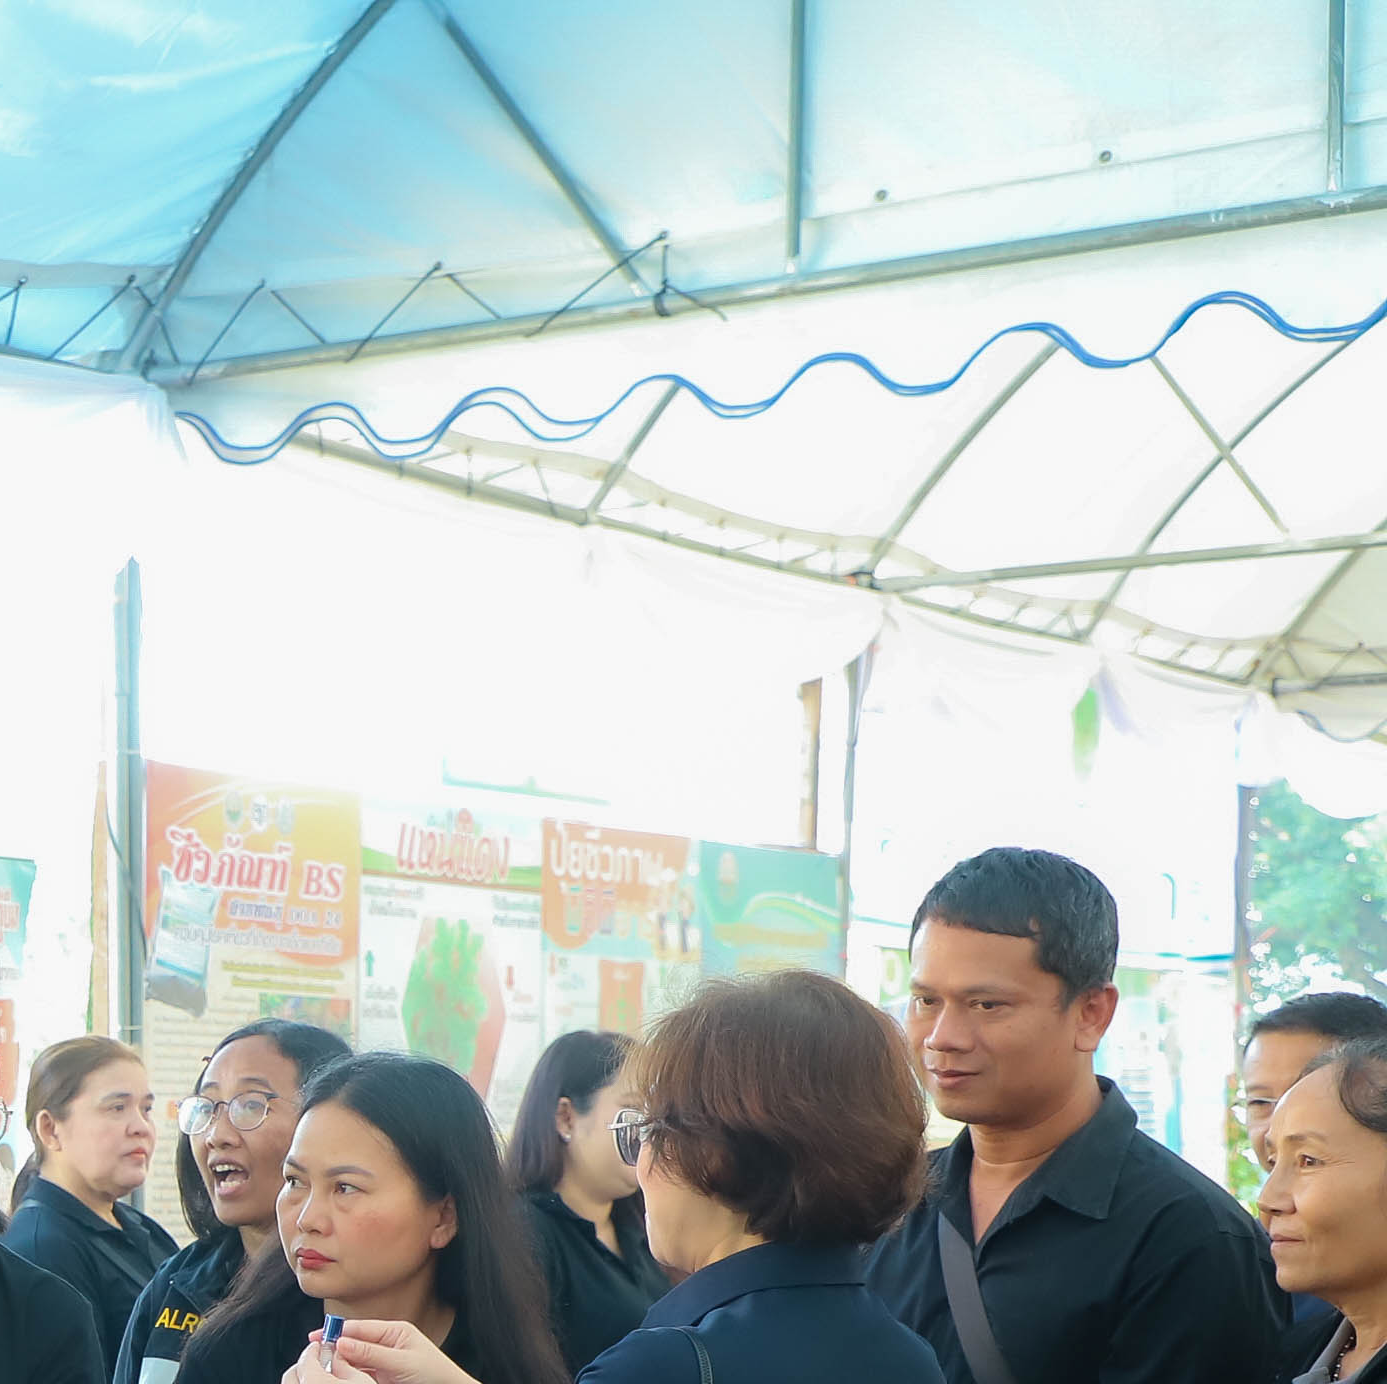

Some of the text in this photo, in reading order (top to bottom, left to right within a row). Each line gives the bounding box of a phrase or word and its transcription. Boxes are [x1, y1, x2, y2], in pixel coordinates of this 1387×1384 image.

[168, 827, 343, 898] ชีวภัณฑ์ BS
[155, 1307, 205, 1334] ALR
